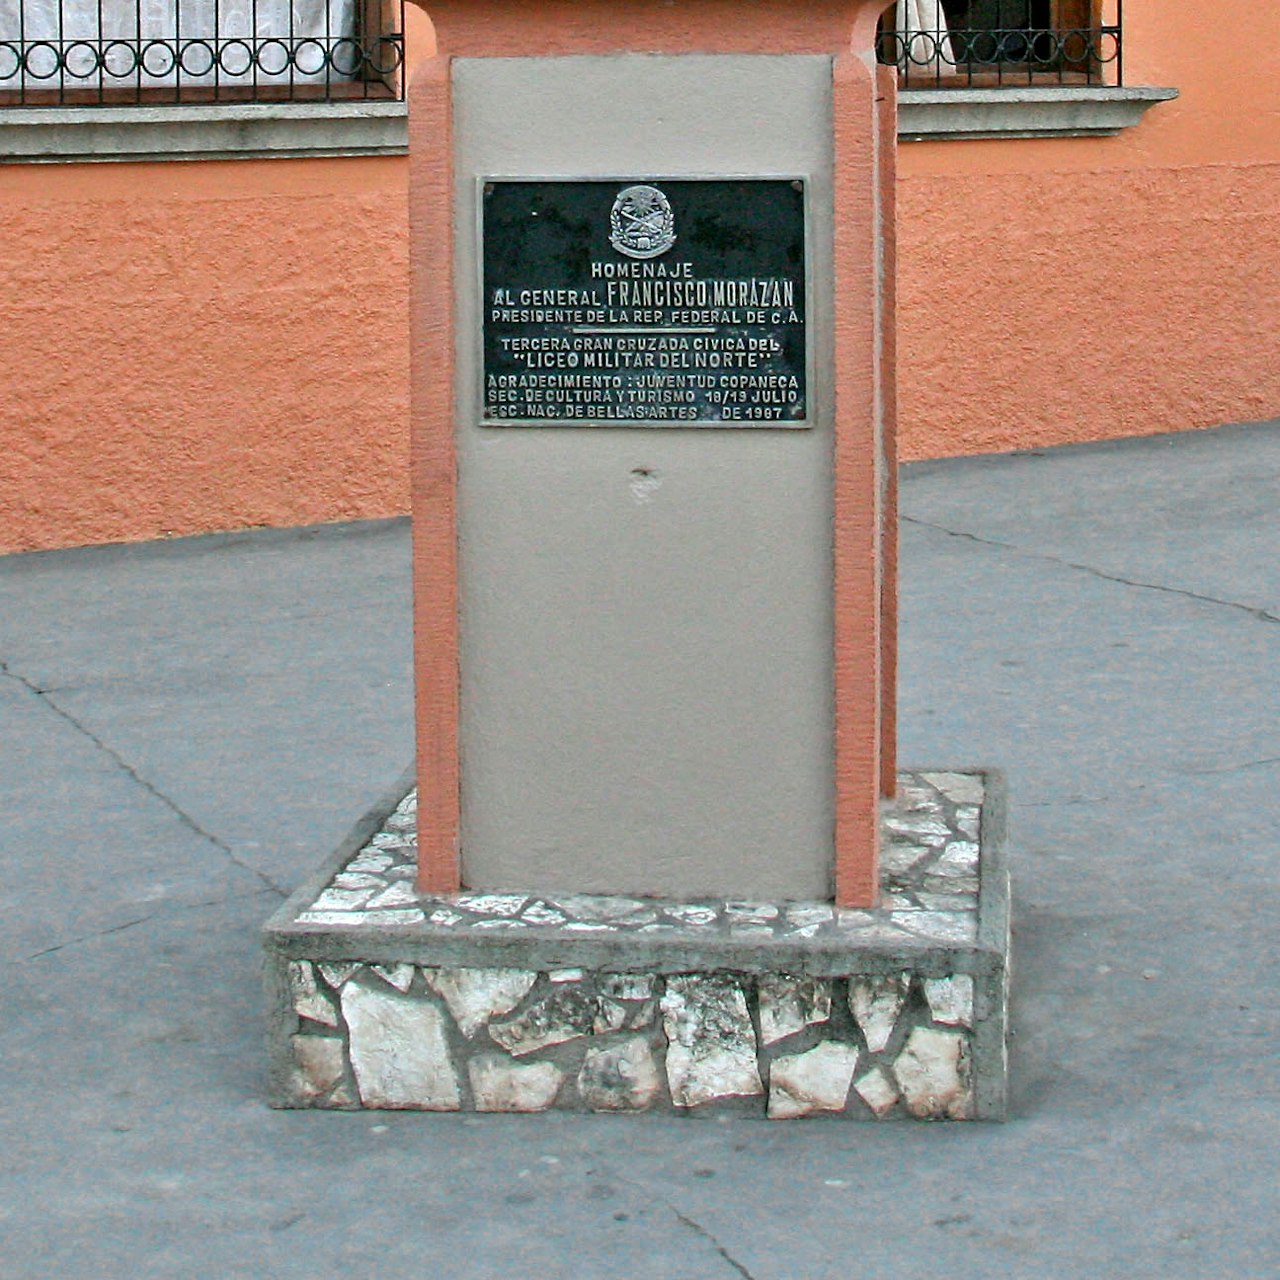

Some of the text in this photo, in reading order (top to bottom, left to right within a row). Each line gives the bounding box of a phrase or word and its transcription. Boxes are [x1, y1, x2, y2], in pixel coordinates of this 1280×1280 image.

[591, 262, 694, 278] HOMENAJE
[494, 290, 515, 306] AL
[520, 290, 601, 307] GENERAL
[607, 281, 706, 307] FRANCISCO
[492, 310, 584, 323] PRESIDENTE
[586, 310, 605, 323] DE
[609, 310, 629, 323] LA
[671, 311, 741, 323] FEDERAL
[747, 311, 766, 323] DE
[502, 339, 570, 350] TERCERA
[574, 339, 613, 351] GRAN
[617, 339, 688, 351] CRUZADA
[584, 353, 653, 368] MILITAR
[660, 353, 690, 368] DEL
[488, 375, 621, 388] AGRADECIMIENTO
[636, 375, 715, 388] JUVENTUD
[720, 376, 798, 388] COPANECA
[546, 390, 612, 402] CULTURA
[616, 390, 625, 402] Y
[628, 390, 695, 402] TURISMO
[752, 391, 798, 403] JULIO
[566, 406, 585, 418] DE
[647, 406, 697, 419] ARTES
[722, 407, 743, 419] DE
[745, 407, 783, 419] 1987
